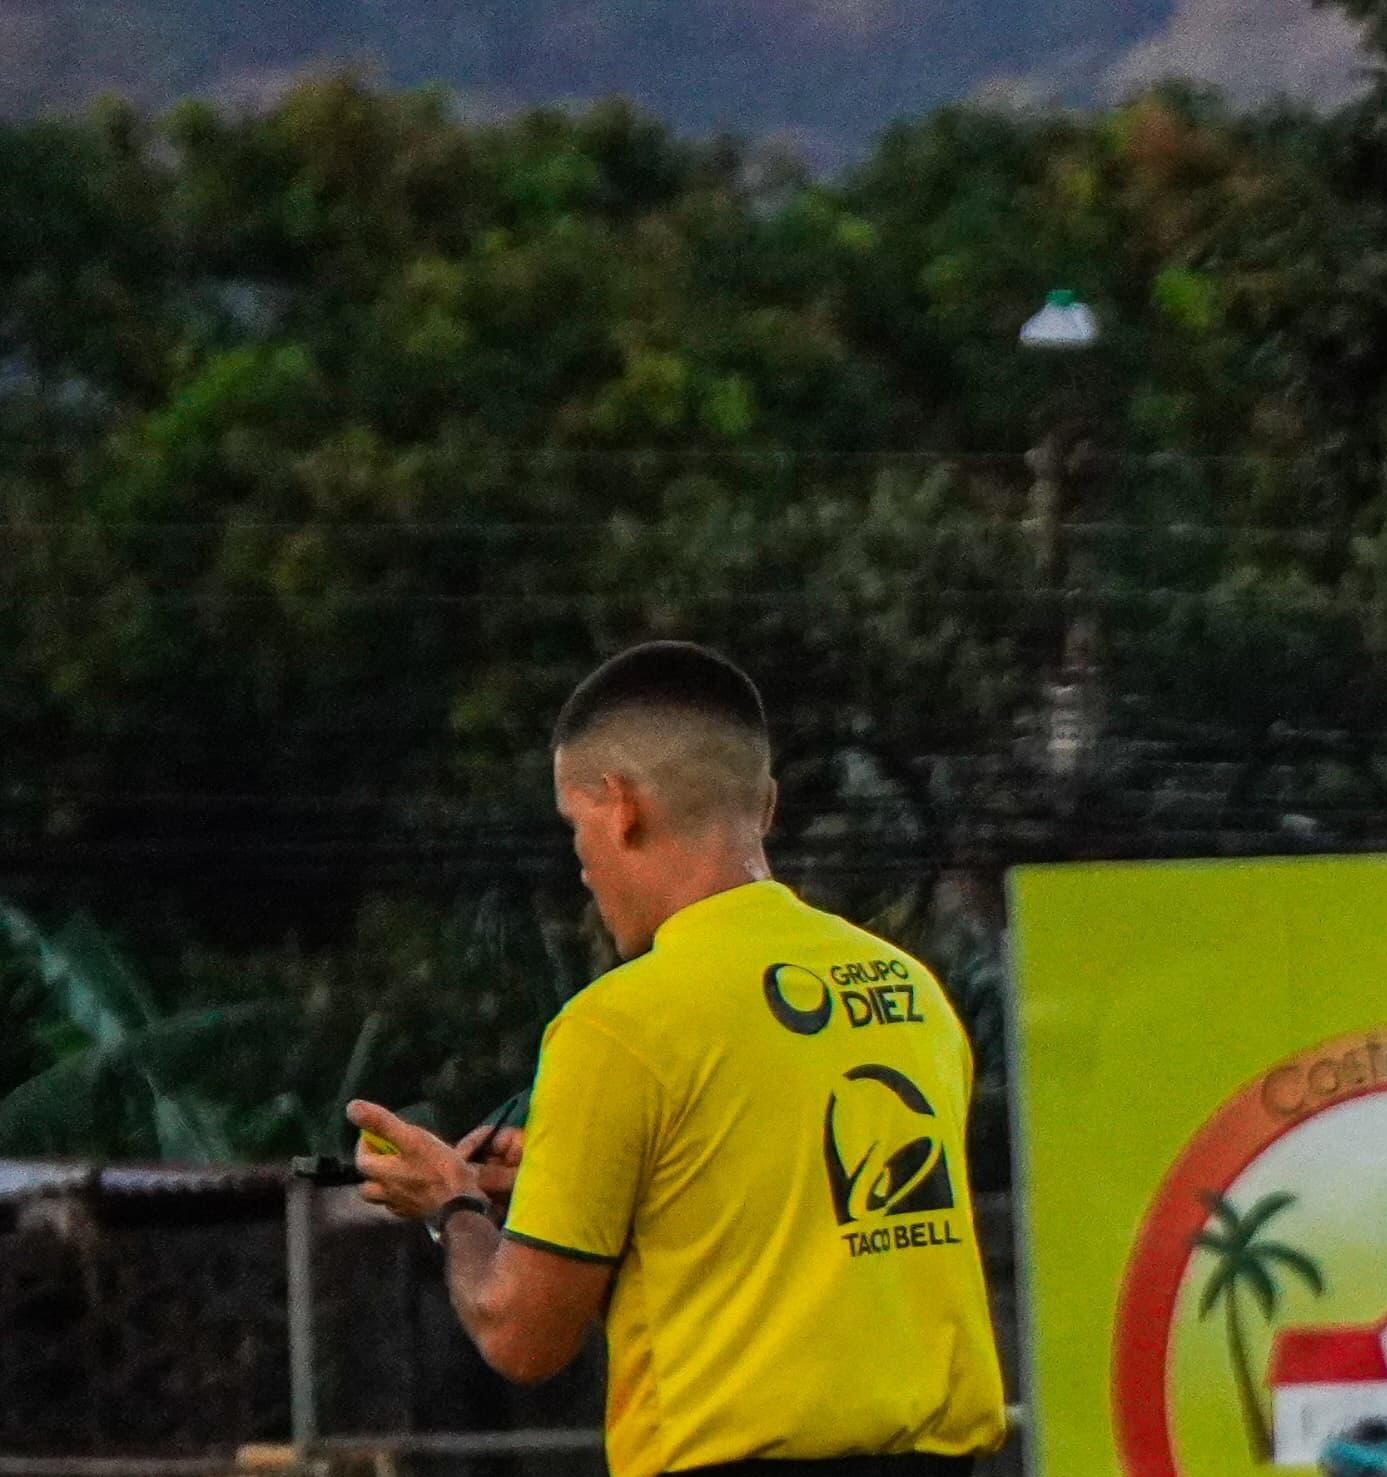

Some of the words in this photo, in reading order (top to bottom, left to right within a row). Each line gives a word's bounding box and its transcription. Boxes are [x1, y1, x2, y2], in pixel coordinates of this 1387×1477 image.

[830, 959, 909, 986] GRUPO
[839, 983, 924, 1029] DIEZ
[841, 1231, 891, 1257] TACO
[894, 1221, 961, 1249] BELL
